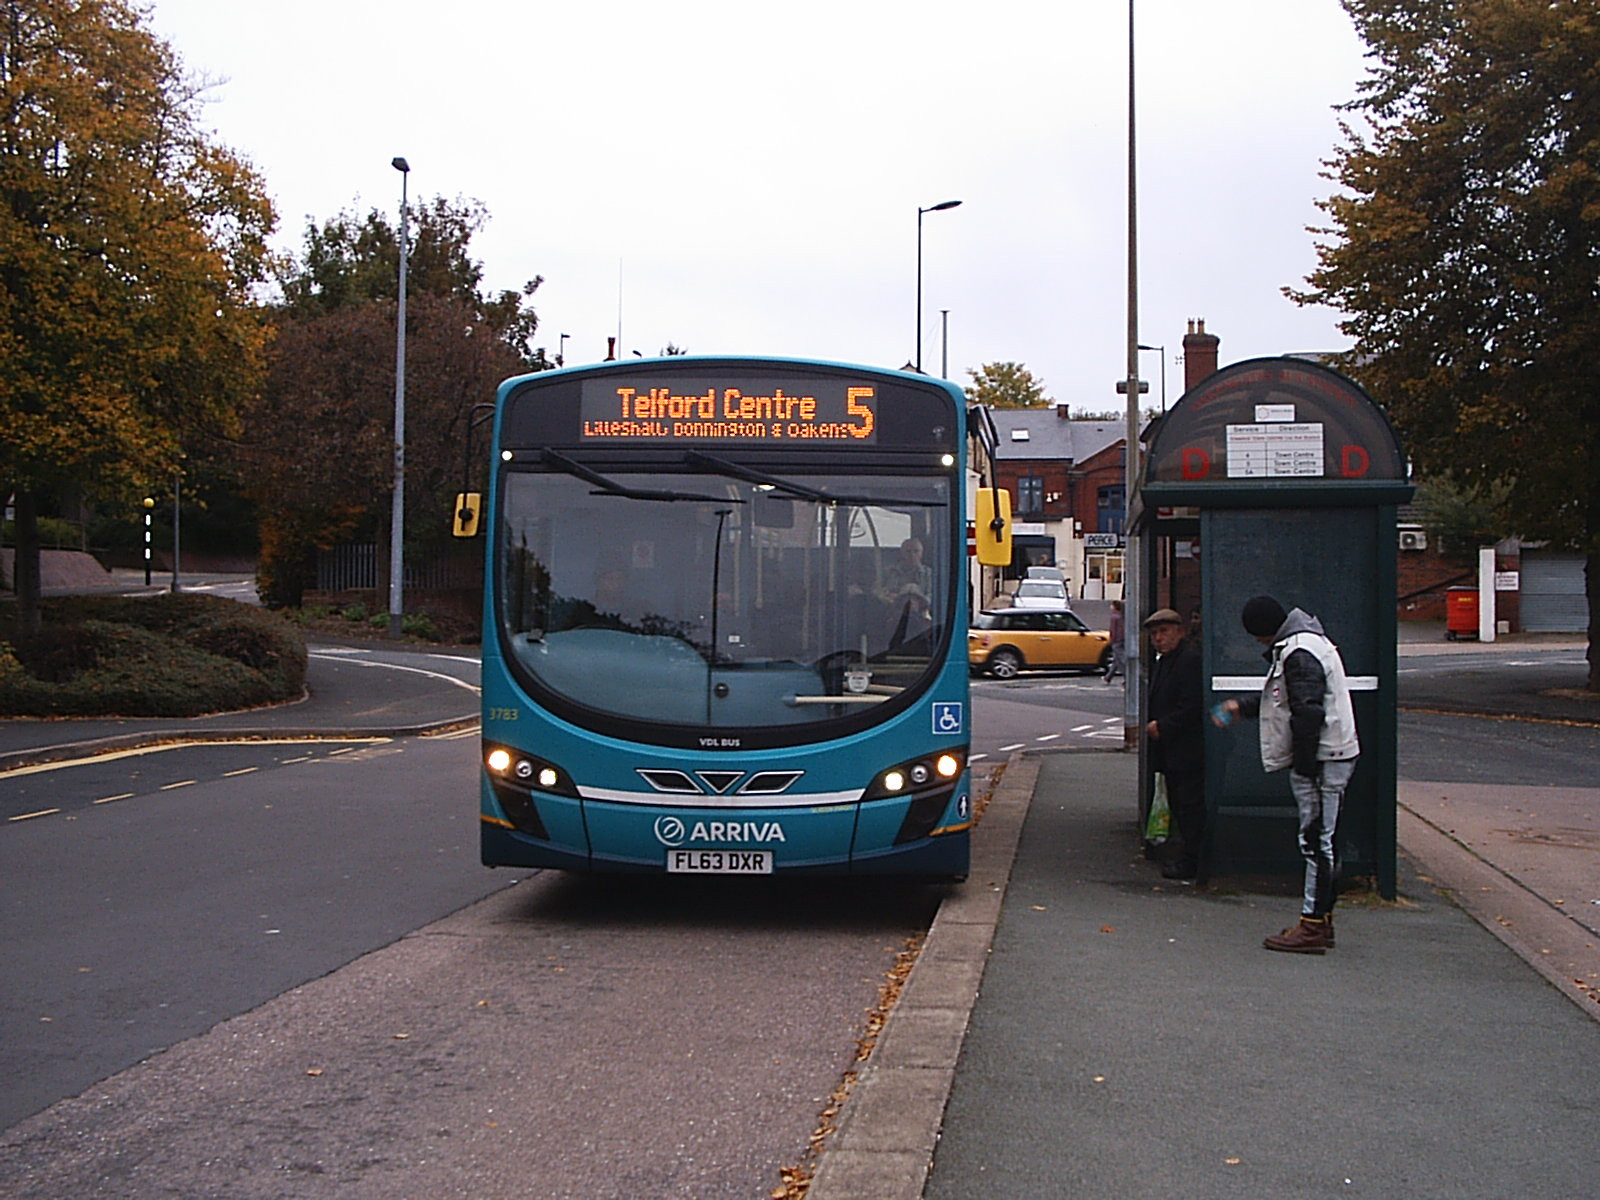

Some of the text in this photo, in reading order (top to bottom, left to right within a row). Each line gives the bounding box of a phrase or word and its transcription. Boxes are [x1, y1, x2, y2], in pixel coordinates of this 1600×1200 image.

[617, 388, 816, 419] Telford Centre
[847, 386, 874, 438] 5
[673, 422, 766, 438] Donnington
[1181, 447, 1210, 480] D
[1341, 445, 1370, 478] D
[699, 738, 741, 747] VDL BUS
[689, 822, 786, 842] ARRIVA
[675, 852, 764, 870] FL63 DXR
